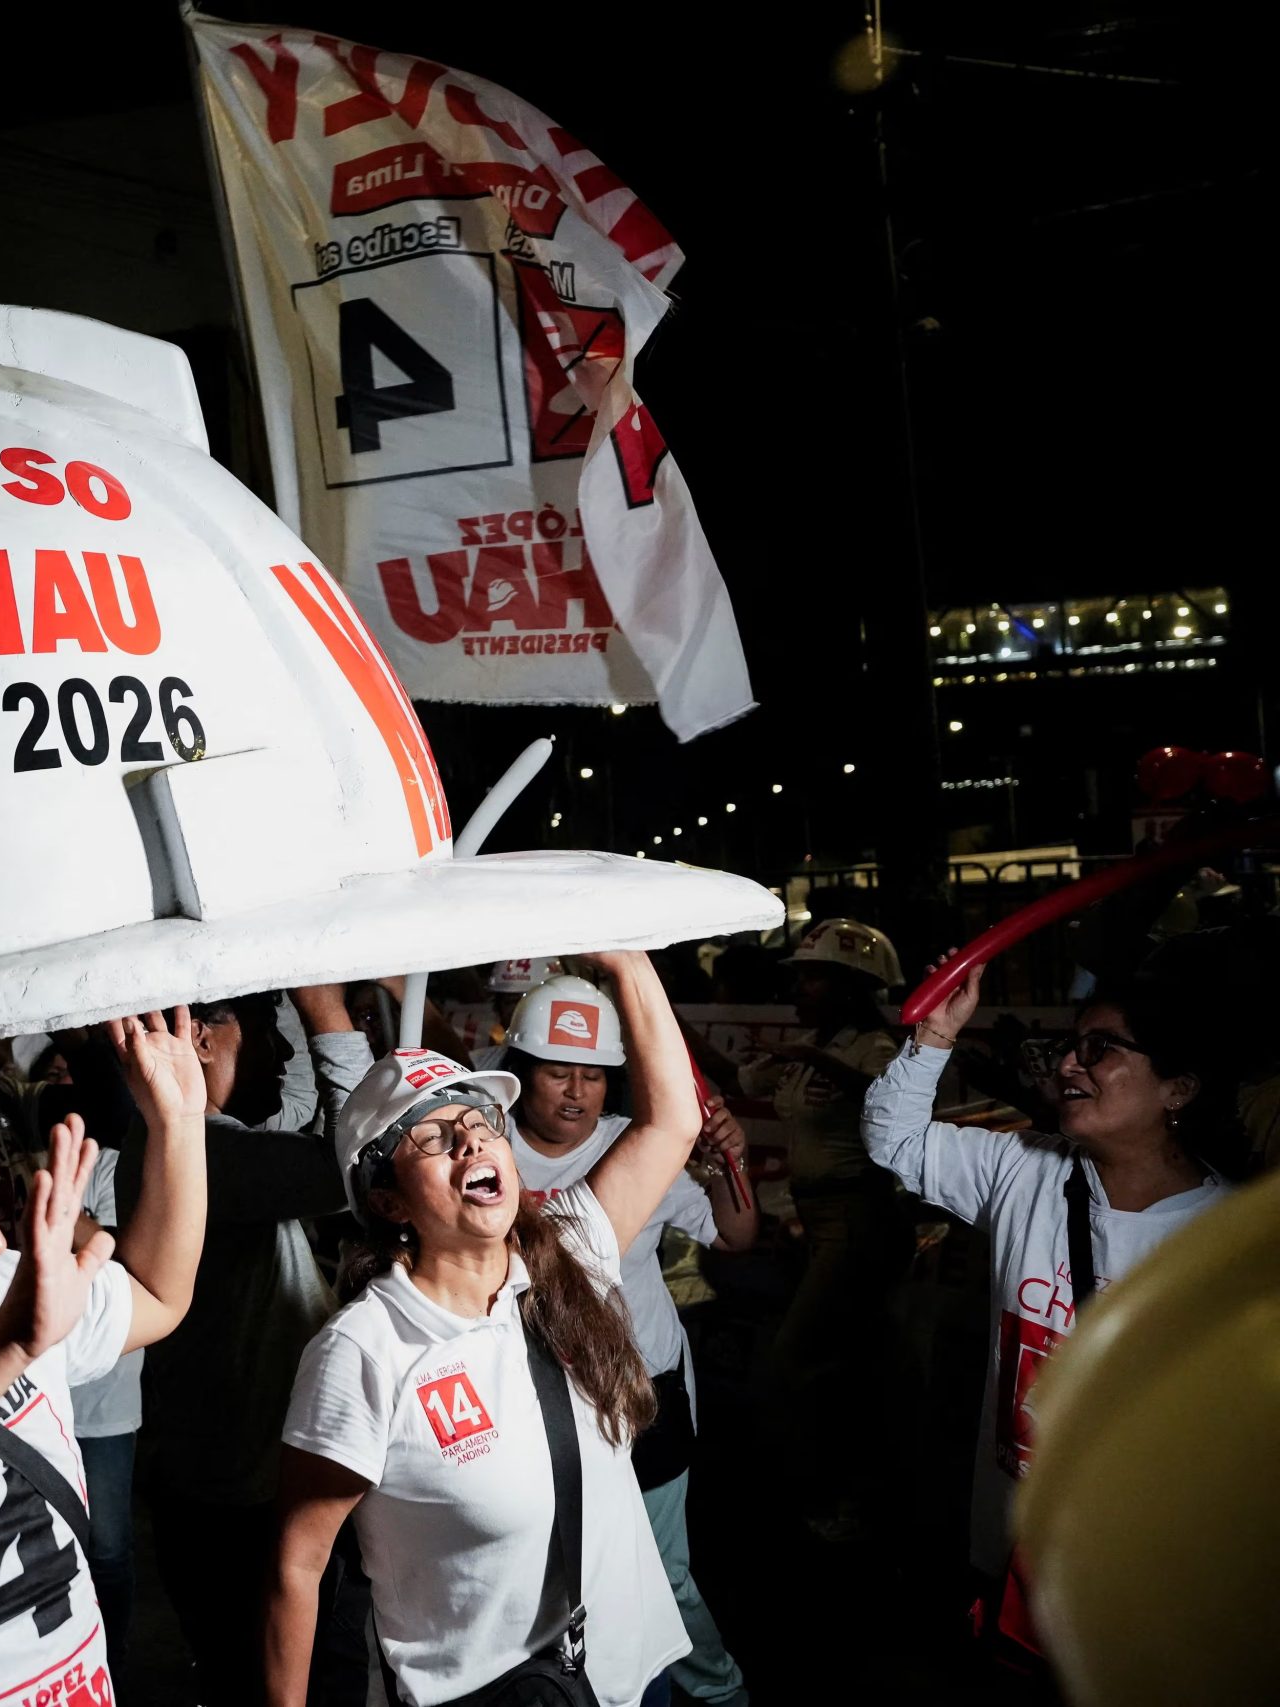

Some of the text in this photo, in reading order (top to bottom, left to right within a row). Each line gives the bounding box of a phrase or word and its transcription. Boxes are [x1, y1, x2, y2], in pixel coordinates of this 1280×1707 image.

[2, 675, 206, 774] 2026
[1018, 1278, 1076, 1328] CH
[426, 1382, 483, 1437] 14
[441, 1429, 499, 1460] PARLAMENTO
[457, 1445, 491, 1467] ANDINO
[22, 1661, 87, 1707] OPEZ
